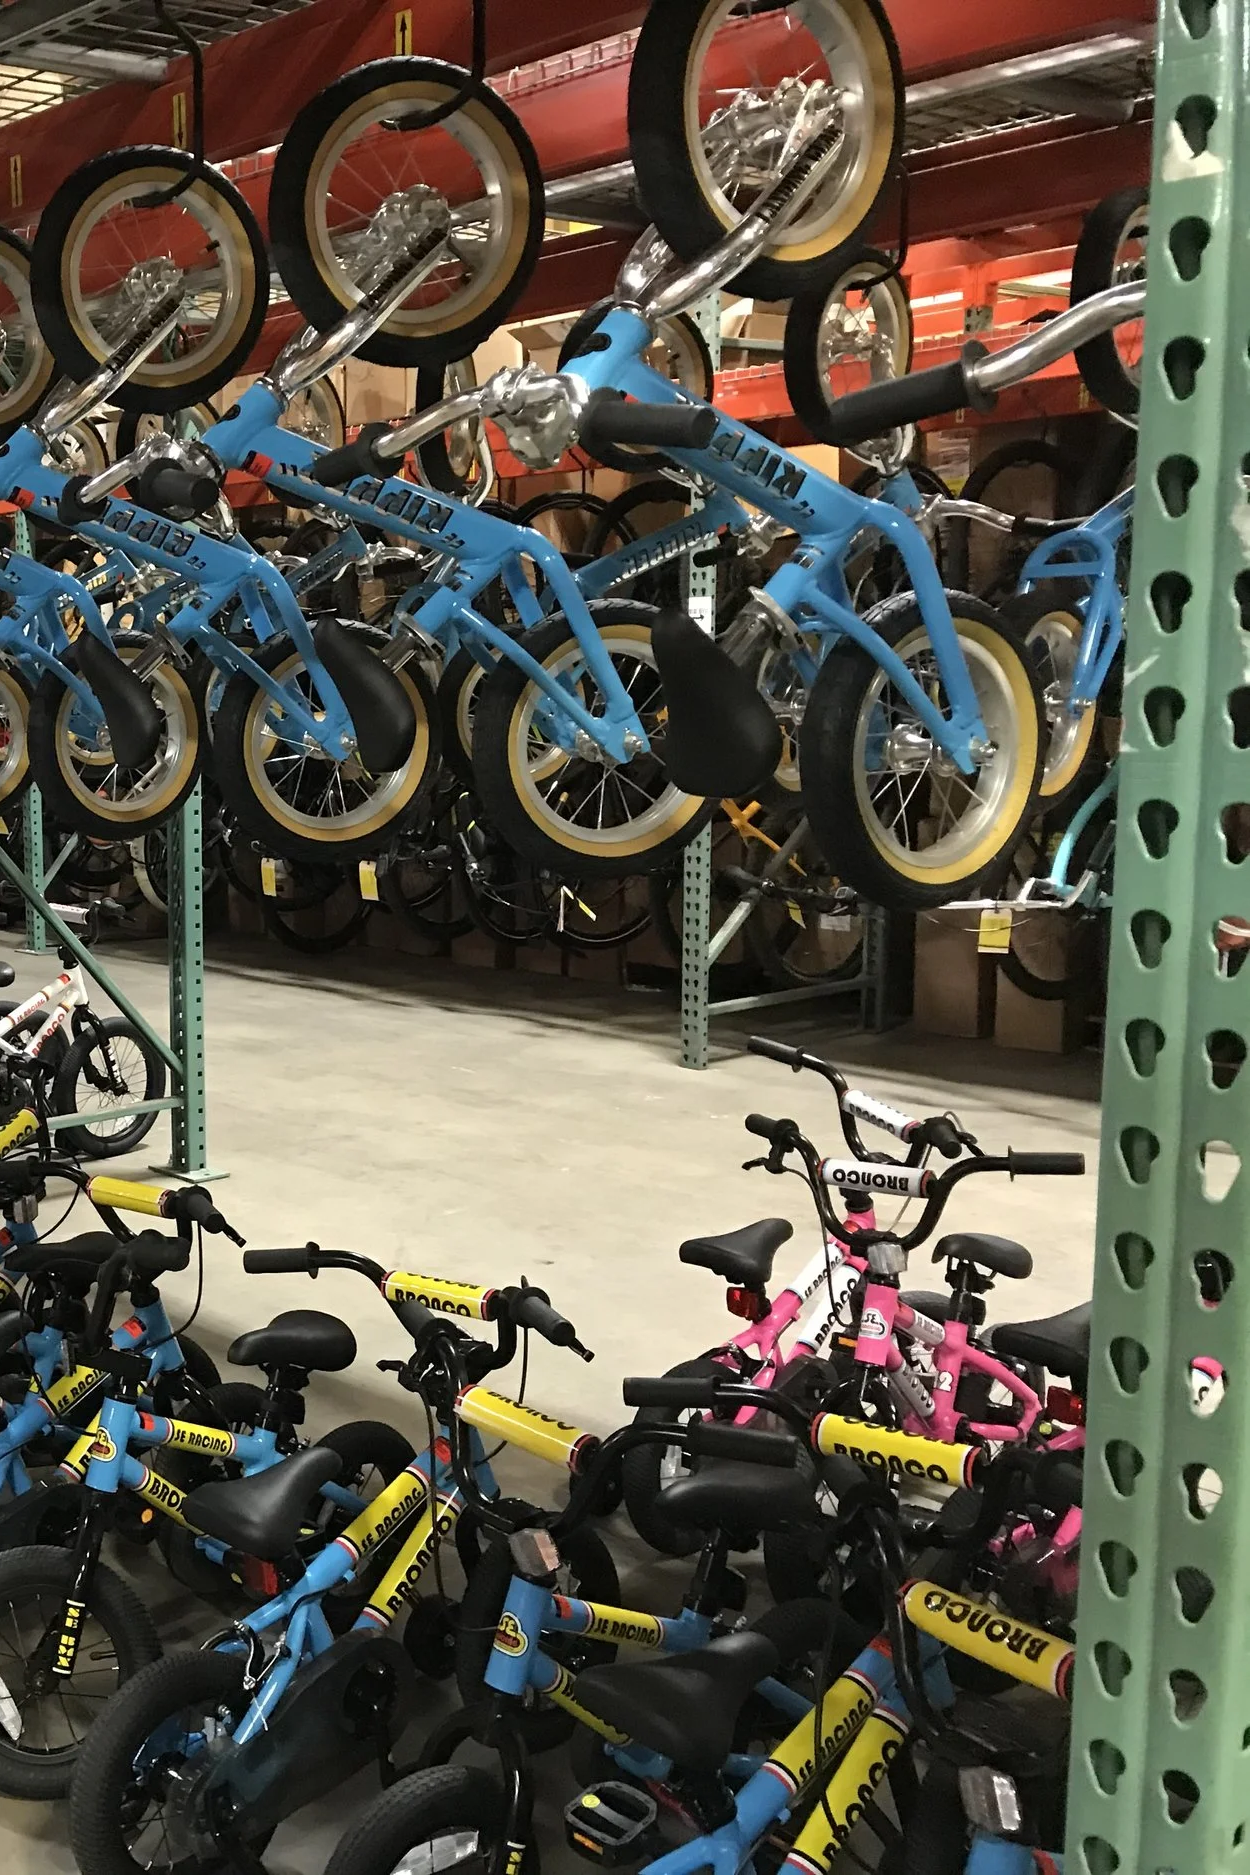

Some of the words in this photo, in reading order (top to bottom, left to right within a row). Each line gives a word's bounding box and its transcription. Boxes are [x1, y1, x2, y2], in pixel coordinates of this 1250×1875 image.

[31, 1012, 66, 1057] BRONCO
[832, 1168, 910, 1192] BRONCO
[57, 1398, 70, 1410] SE
[173, 1429, 187, 1442] SE
[187, 1432, 228, 1452] RACING
[834, 1441, 949, 1484] BRONCO
[359, 1532, 375, 1553] SE
[374, 1487, 422, 1537] RACING
[386, 1515, 453, 1614] BRONCO
[594, 1617, 609, 1633] SE
[610, 1620, 657, 1645] RACING
[923, 1590, 1051, 1662] BRONCO
